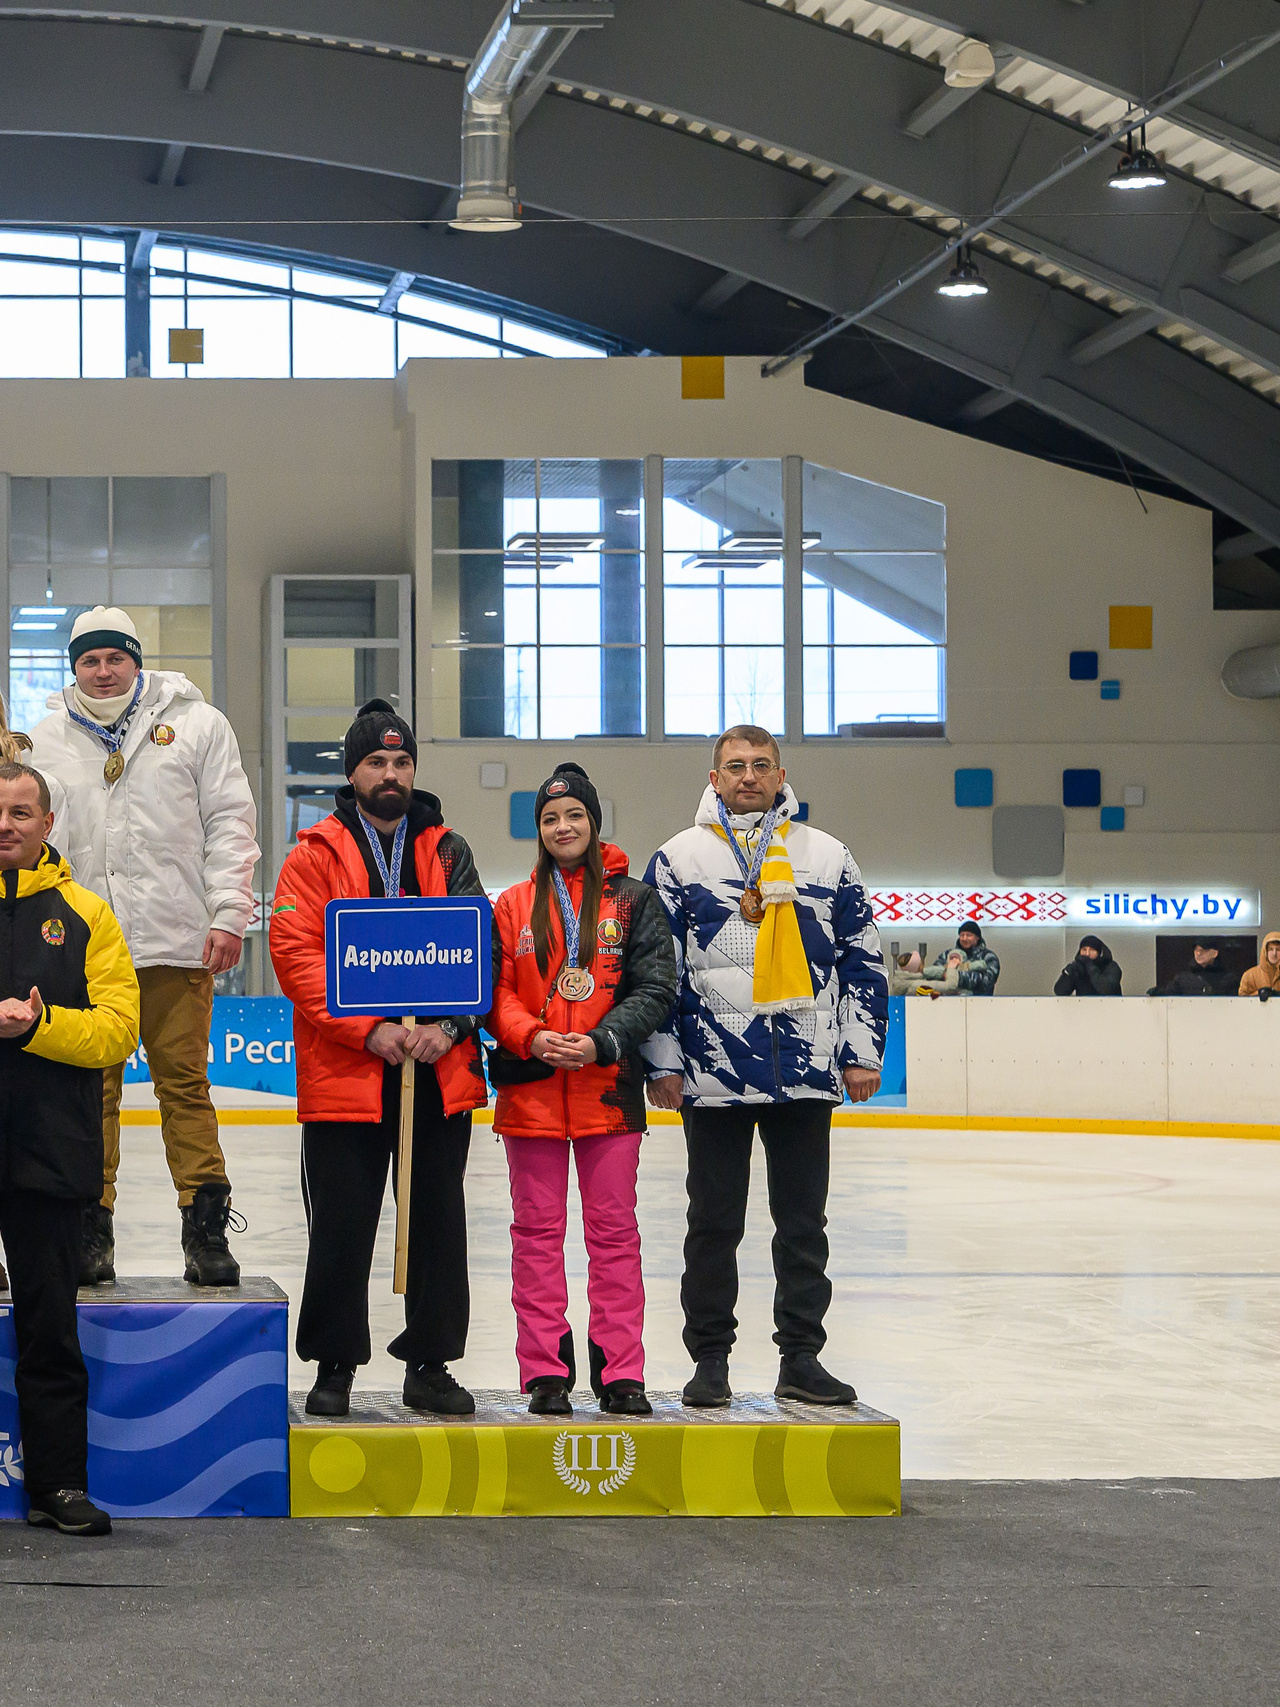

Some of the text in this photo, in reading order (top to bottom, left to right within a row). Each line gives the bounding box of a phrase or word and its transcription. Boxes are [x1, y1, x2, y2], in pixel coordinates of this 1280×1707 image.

[1086, 893, 1242, 920] silichy.by
[344, 941, 474, 973] Агрохолдинг
[598, 947, 623, 956] BELARUS
[567, 1434, 622, 1471] III
